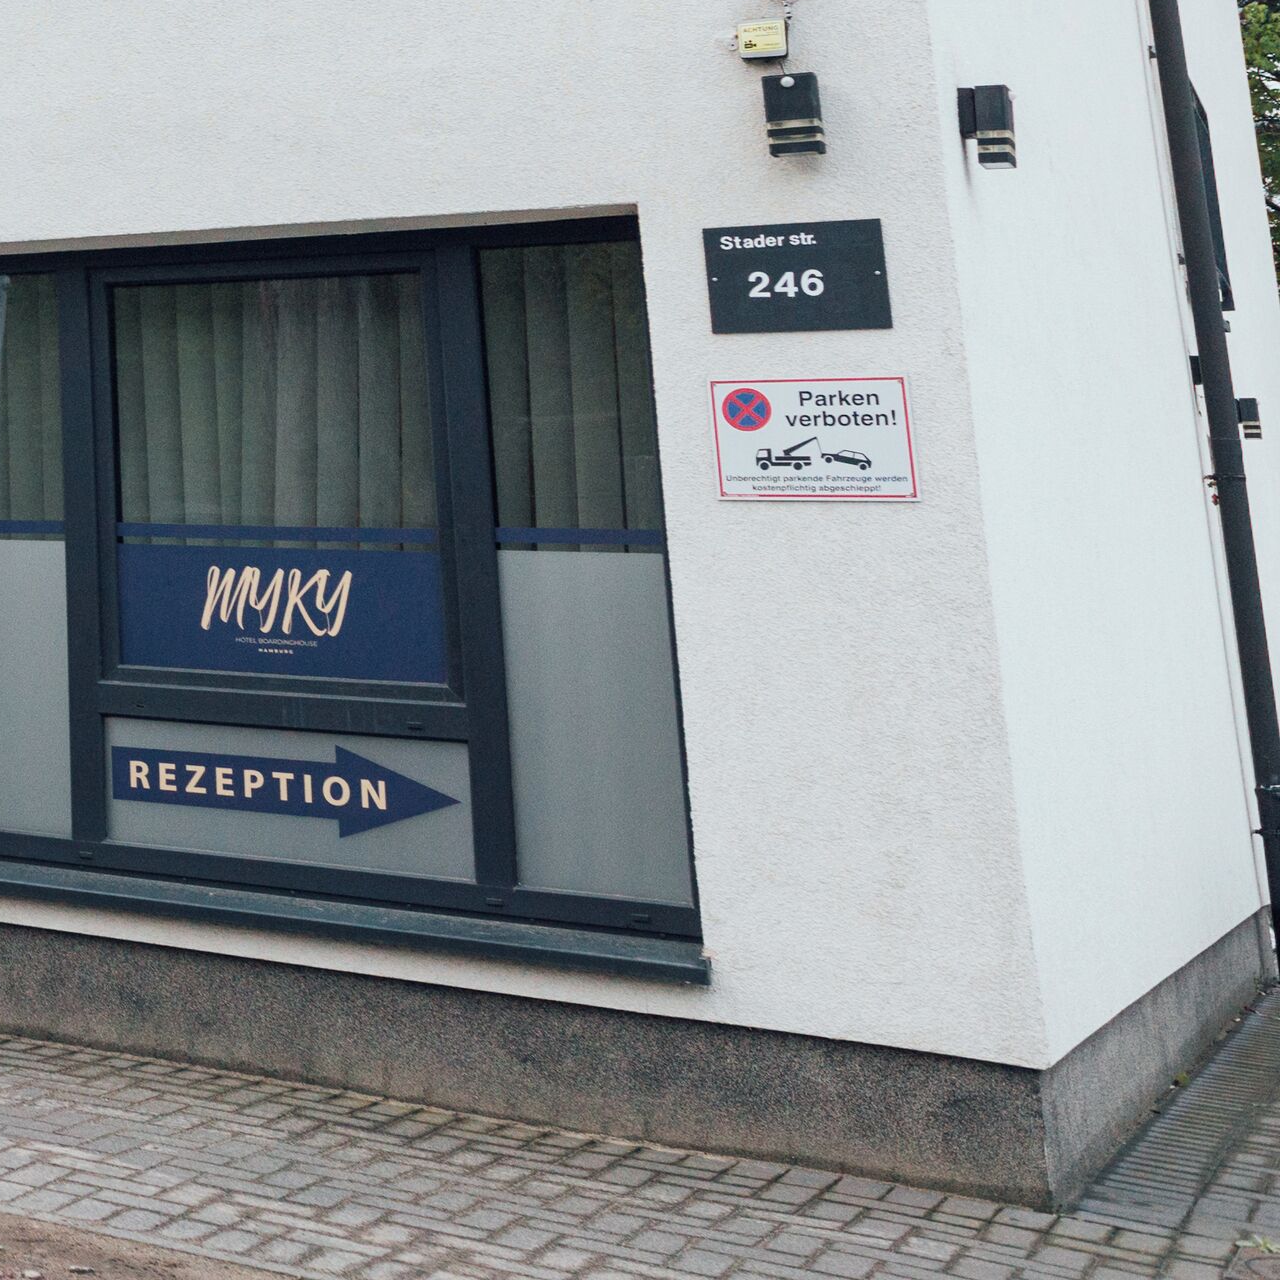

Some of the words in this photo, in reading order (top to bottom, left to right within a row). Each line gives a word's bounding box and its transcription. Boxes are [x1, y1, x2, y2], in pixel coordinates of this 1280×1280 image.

[720, 234, 785, 250] Stader
[789, 232, 817, 246] str.
[747, 269, 825, 298] 246
[799, 390, 880, 406] Parken
[785, 410, 897, 427] verboten!
[725, 474, 781, 484] Unberechtigt
[783, 475, 823, 484] parkende
[826, 475, 873, 484] Fahrzeuge
[875, 475, 909, 483] werden
[200, 565, 353, 637] MYKY
[129, 760, 387, 810] REZEPTION
